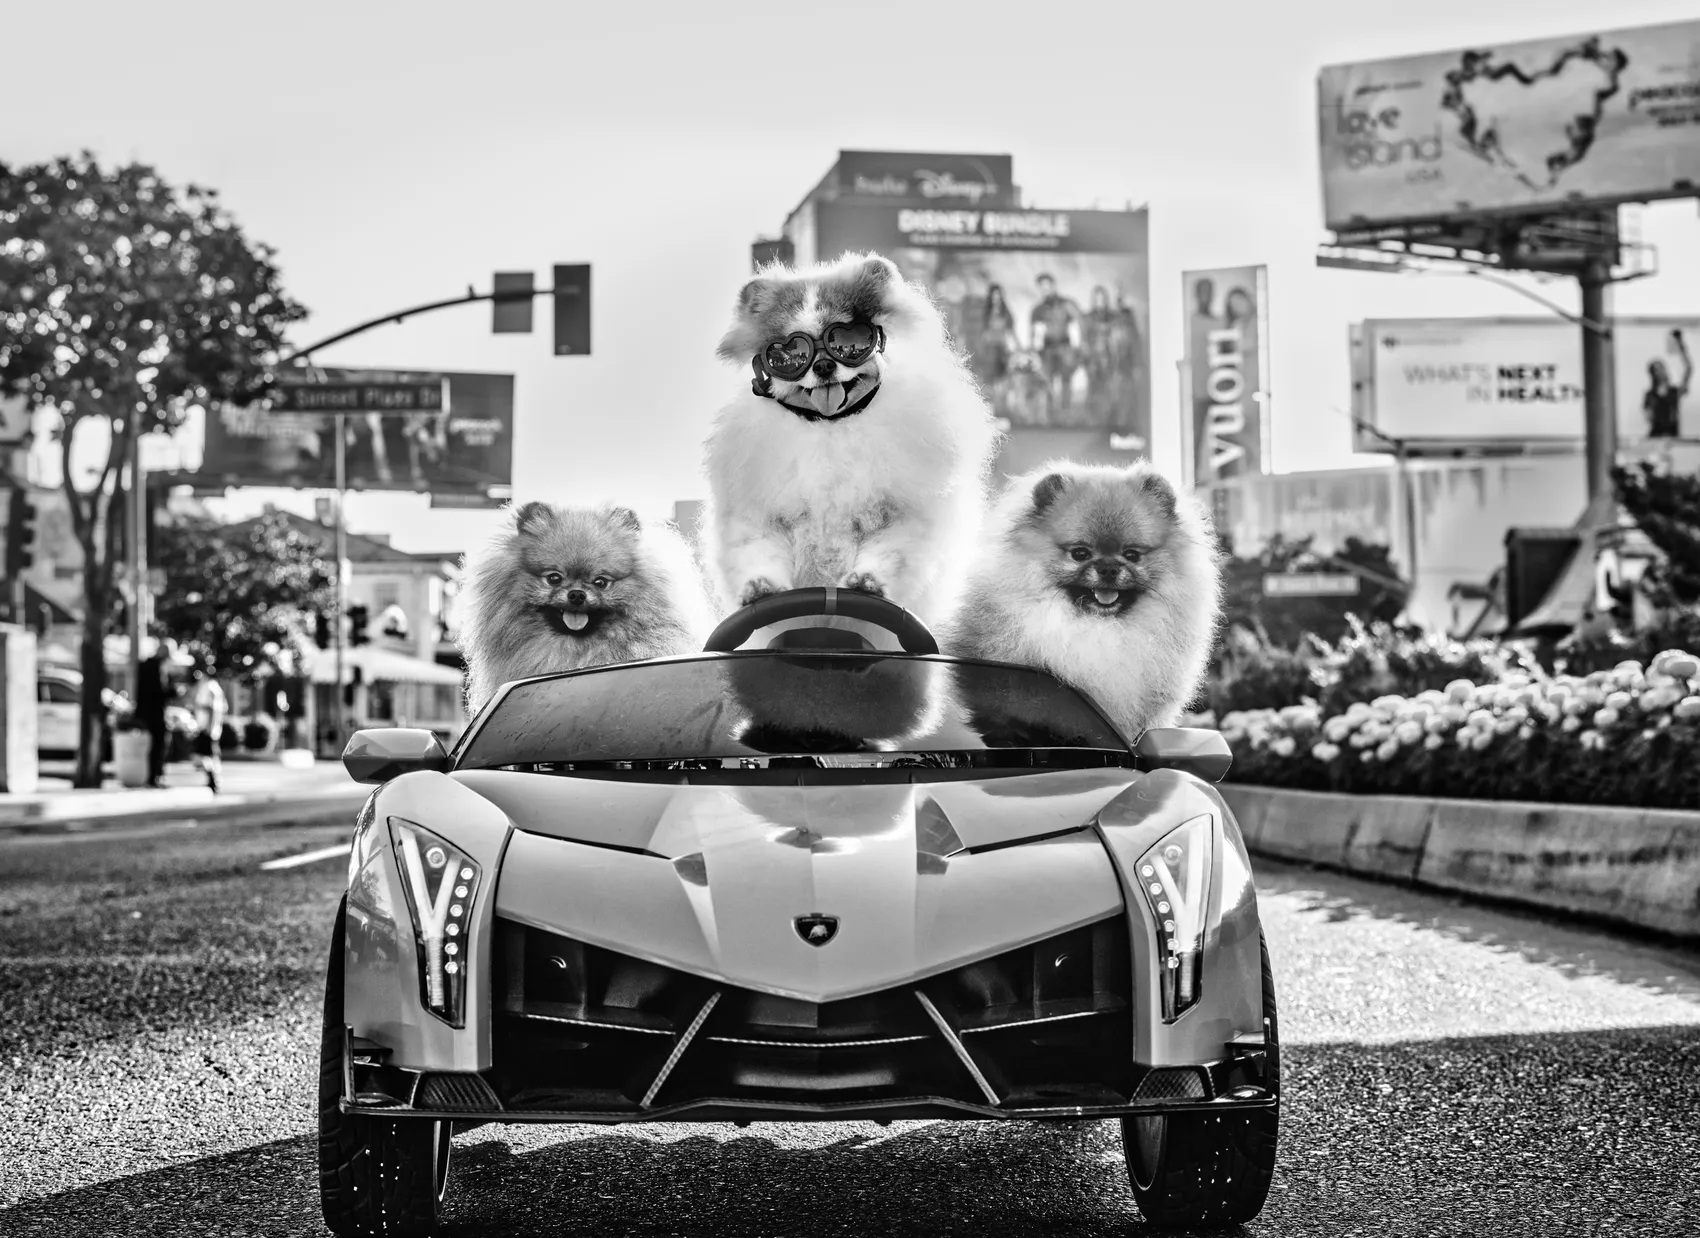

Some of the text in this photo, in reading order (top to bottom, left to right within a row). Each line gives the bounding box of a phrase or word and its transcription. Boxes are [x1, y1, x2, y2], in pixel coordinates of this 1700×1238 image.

[898, 209, 1070, 237] DISNEY BUNDLE
[1497, 363, 1558, 381] NEXT
[296, 387, 358, 408] Sunset
